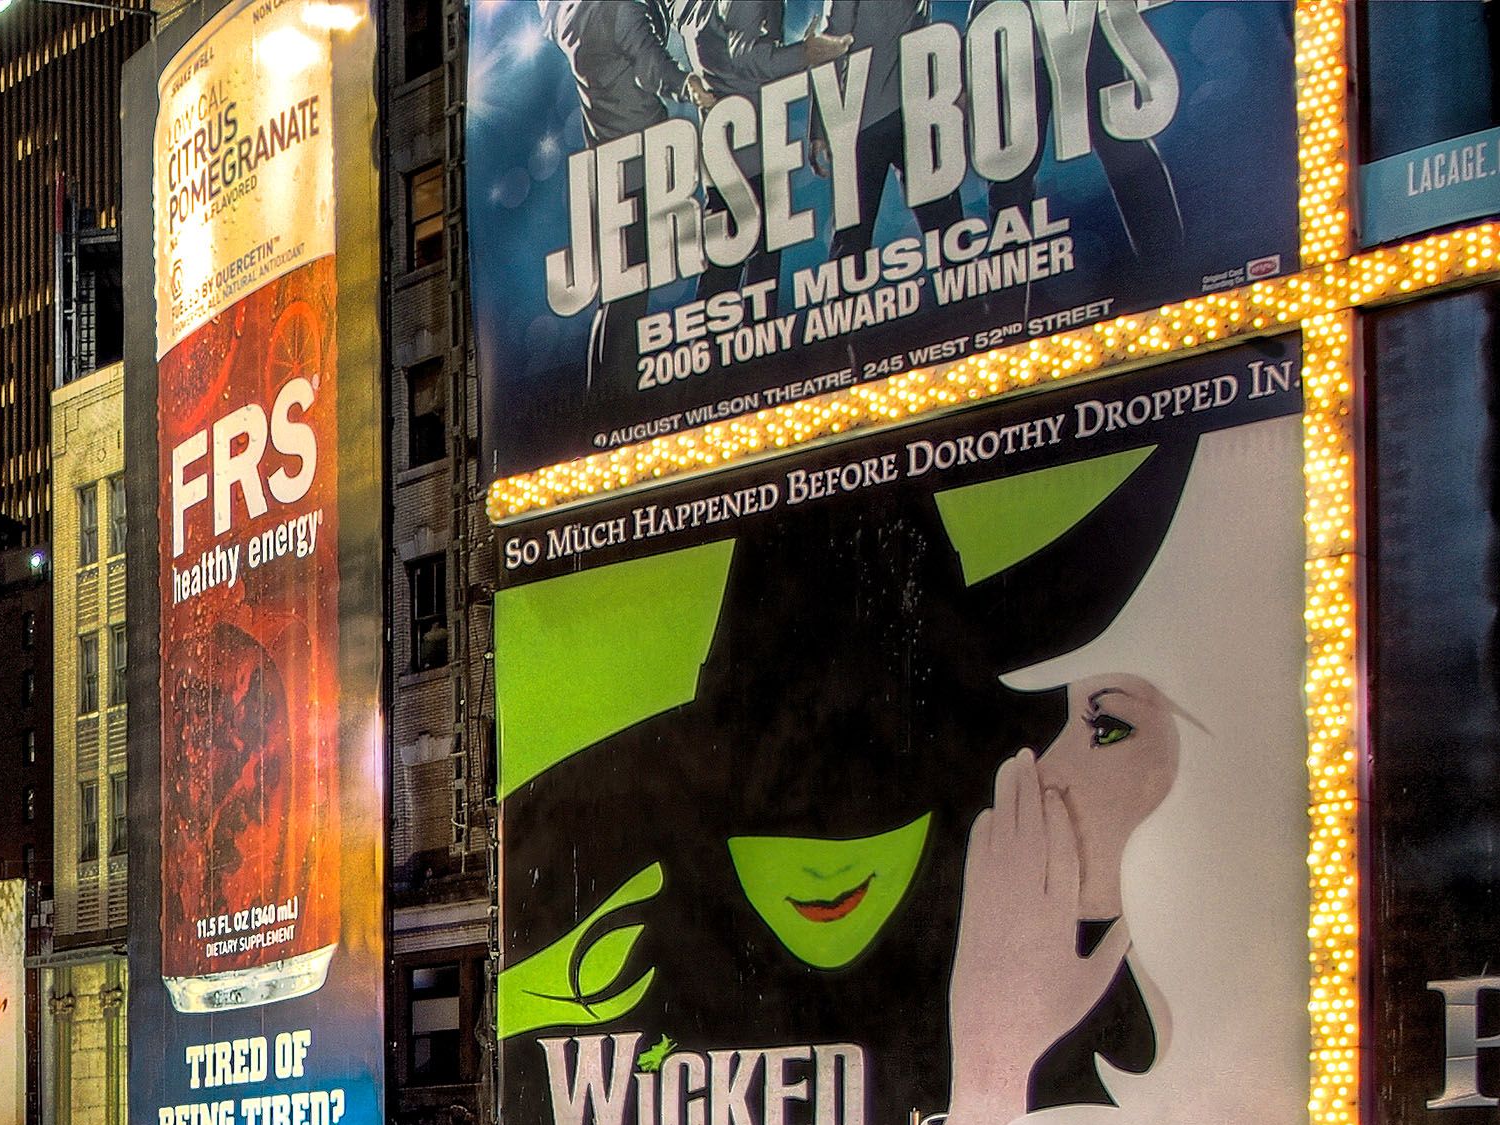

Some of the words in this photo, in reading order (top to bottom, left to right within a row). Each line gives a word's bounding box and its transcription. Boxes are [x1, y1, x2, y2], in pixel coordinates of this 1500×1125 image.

[168, 102, 238, 192] CITRUS
[169, 95, 320, 234] POMEGRANATE
[546, 47, 874, 316] JERSEY
[901, 0, 1180, 207] BOYS
[637, 279, 777, 354] BEST
[793, 197, 1070, 309] MUSICAL
[638, 339, 712, 391] 2006
[716, 313, 798, 368] TONY
[934, 236, 1075, 305] WINNER
[609, 412, 684, 447] AUGUST
[686, 390, 759, 424] WILSON
[763, 369, 857, 405] THEATRE,
[863, 355, 904, 381] 245
[908, 336, 969, 367] WEST
[1027, 298, 1114, 335] STREET
[172, 377, 317, 558] FRS
[547, 518, 626, 561] MUCH
[631, 482, 780, 541] HAPPENED
[786, 454, 898, 505] BEFORE
[906, 414, 1066, 479] DOROTHY
[1074, 374, 1238, 439] DROPPED
[173, 545, 240, 605] healthy
[248, 510, 319, 570] energy
[196, 917, 216, 939] 11.5
[217, 913, 232, 936] FL
[234, 909, 249, 933] OZ
[206, 937, 238, 958] DIETARY
[239, 924, 295, 952] SUPPLEMENT
[186, 1036, 268, 1089] TIRED
[274, 1029, 311, 1079] OF
